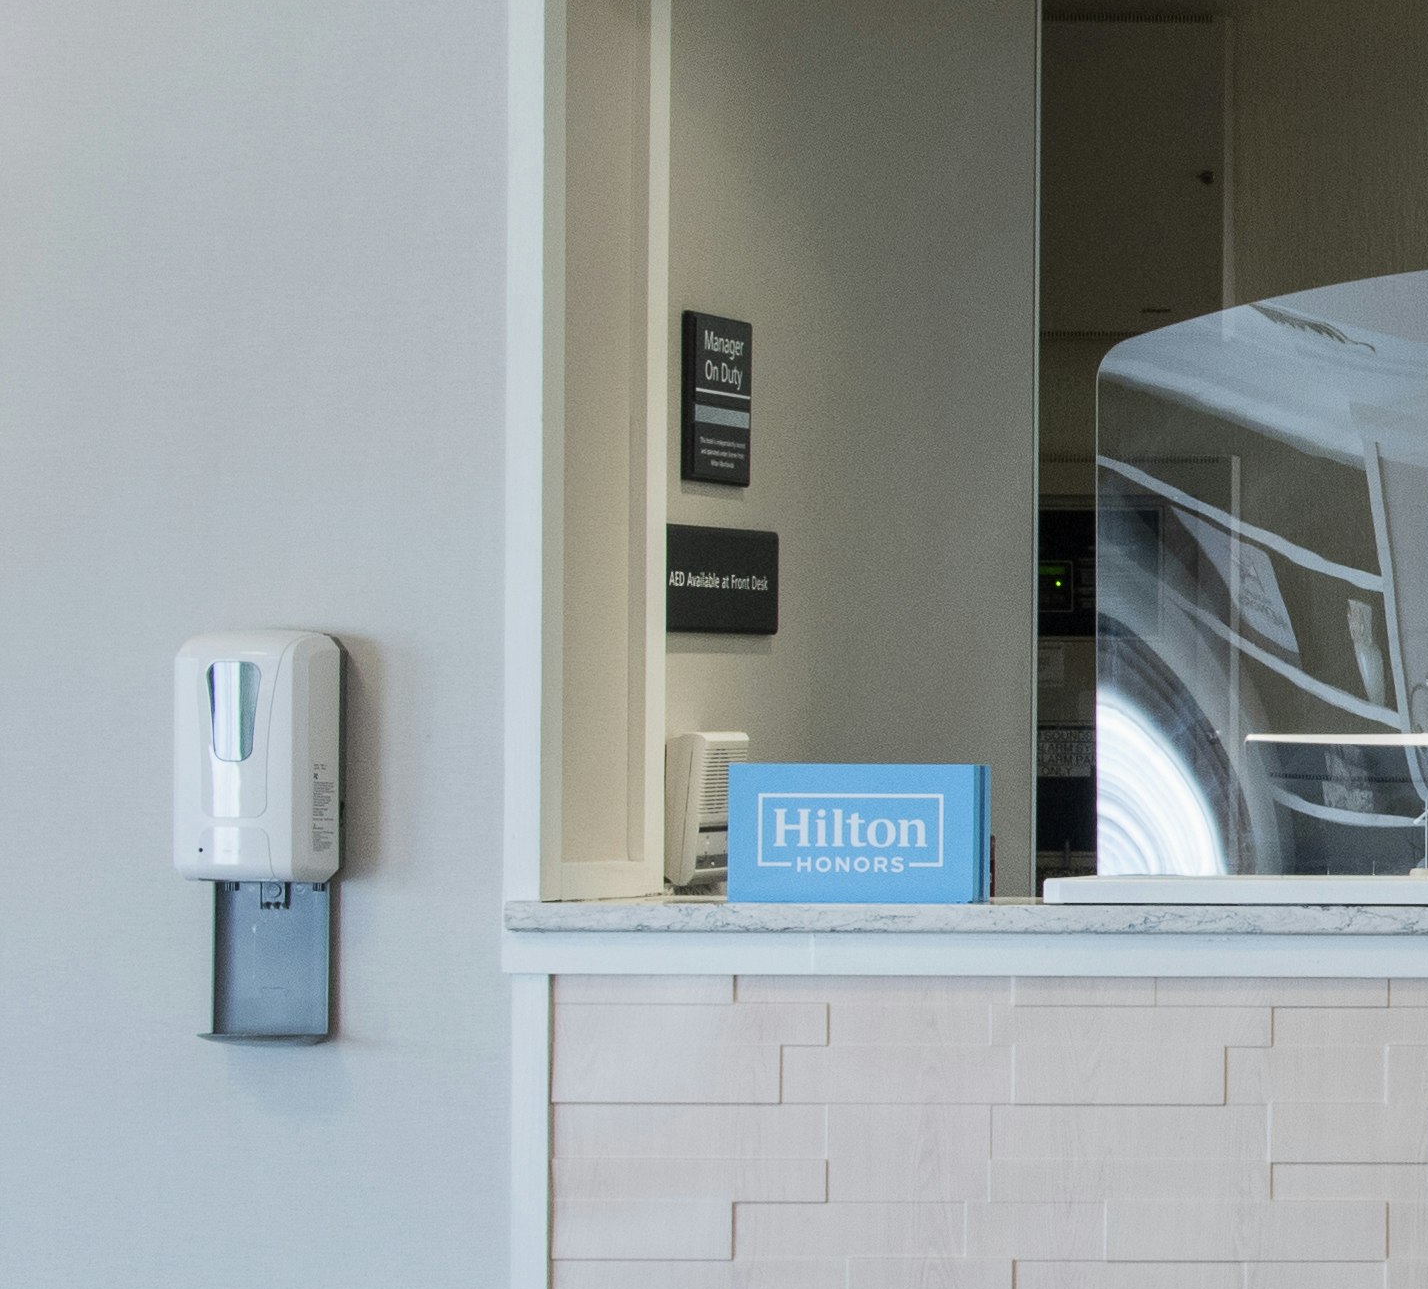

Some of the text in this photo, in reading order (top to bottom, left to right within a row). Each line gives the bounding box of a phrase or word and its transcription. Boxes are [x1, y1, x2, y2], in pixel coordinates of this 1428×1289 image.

[704, 330, 745, 360] Manager
[705, 360, 743, 390] On Duty
[669, 571, 768, 591] AED Available at Front Desk
[773, 808, 928, 848] Hilton
[796, 856, 905, 873] HONORS
